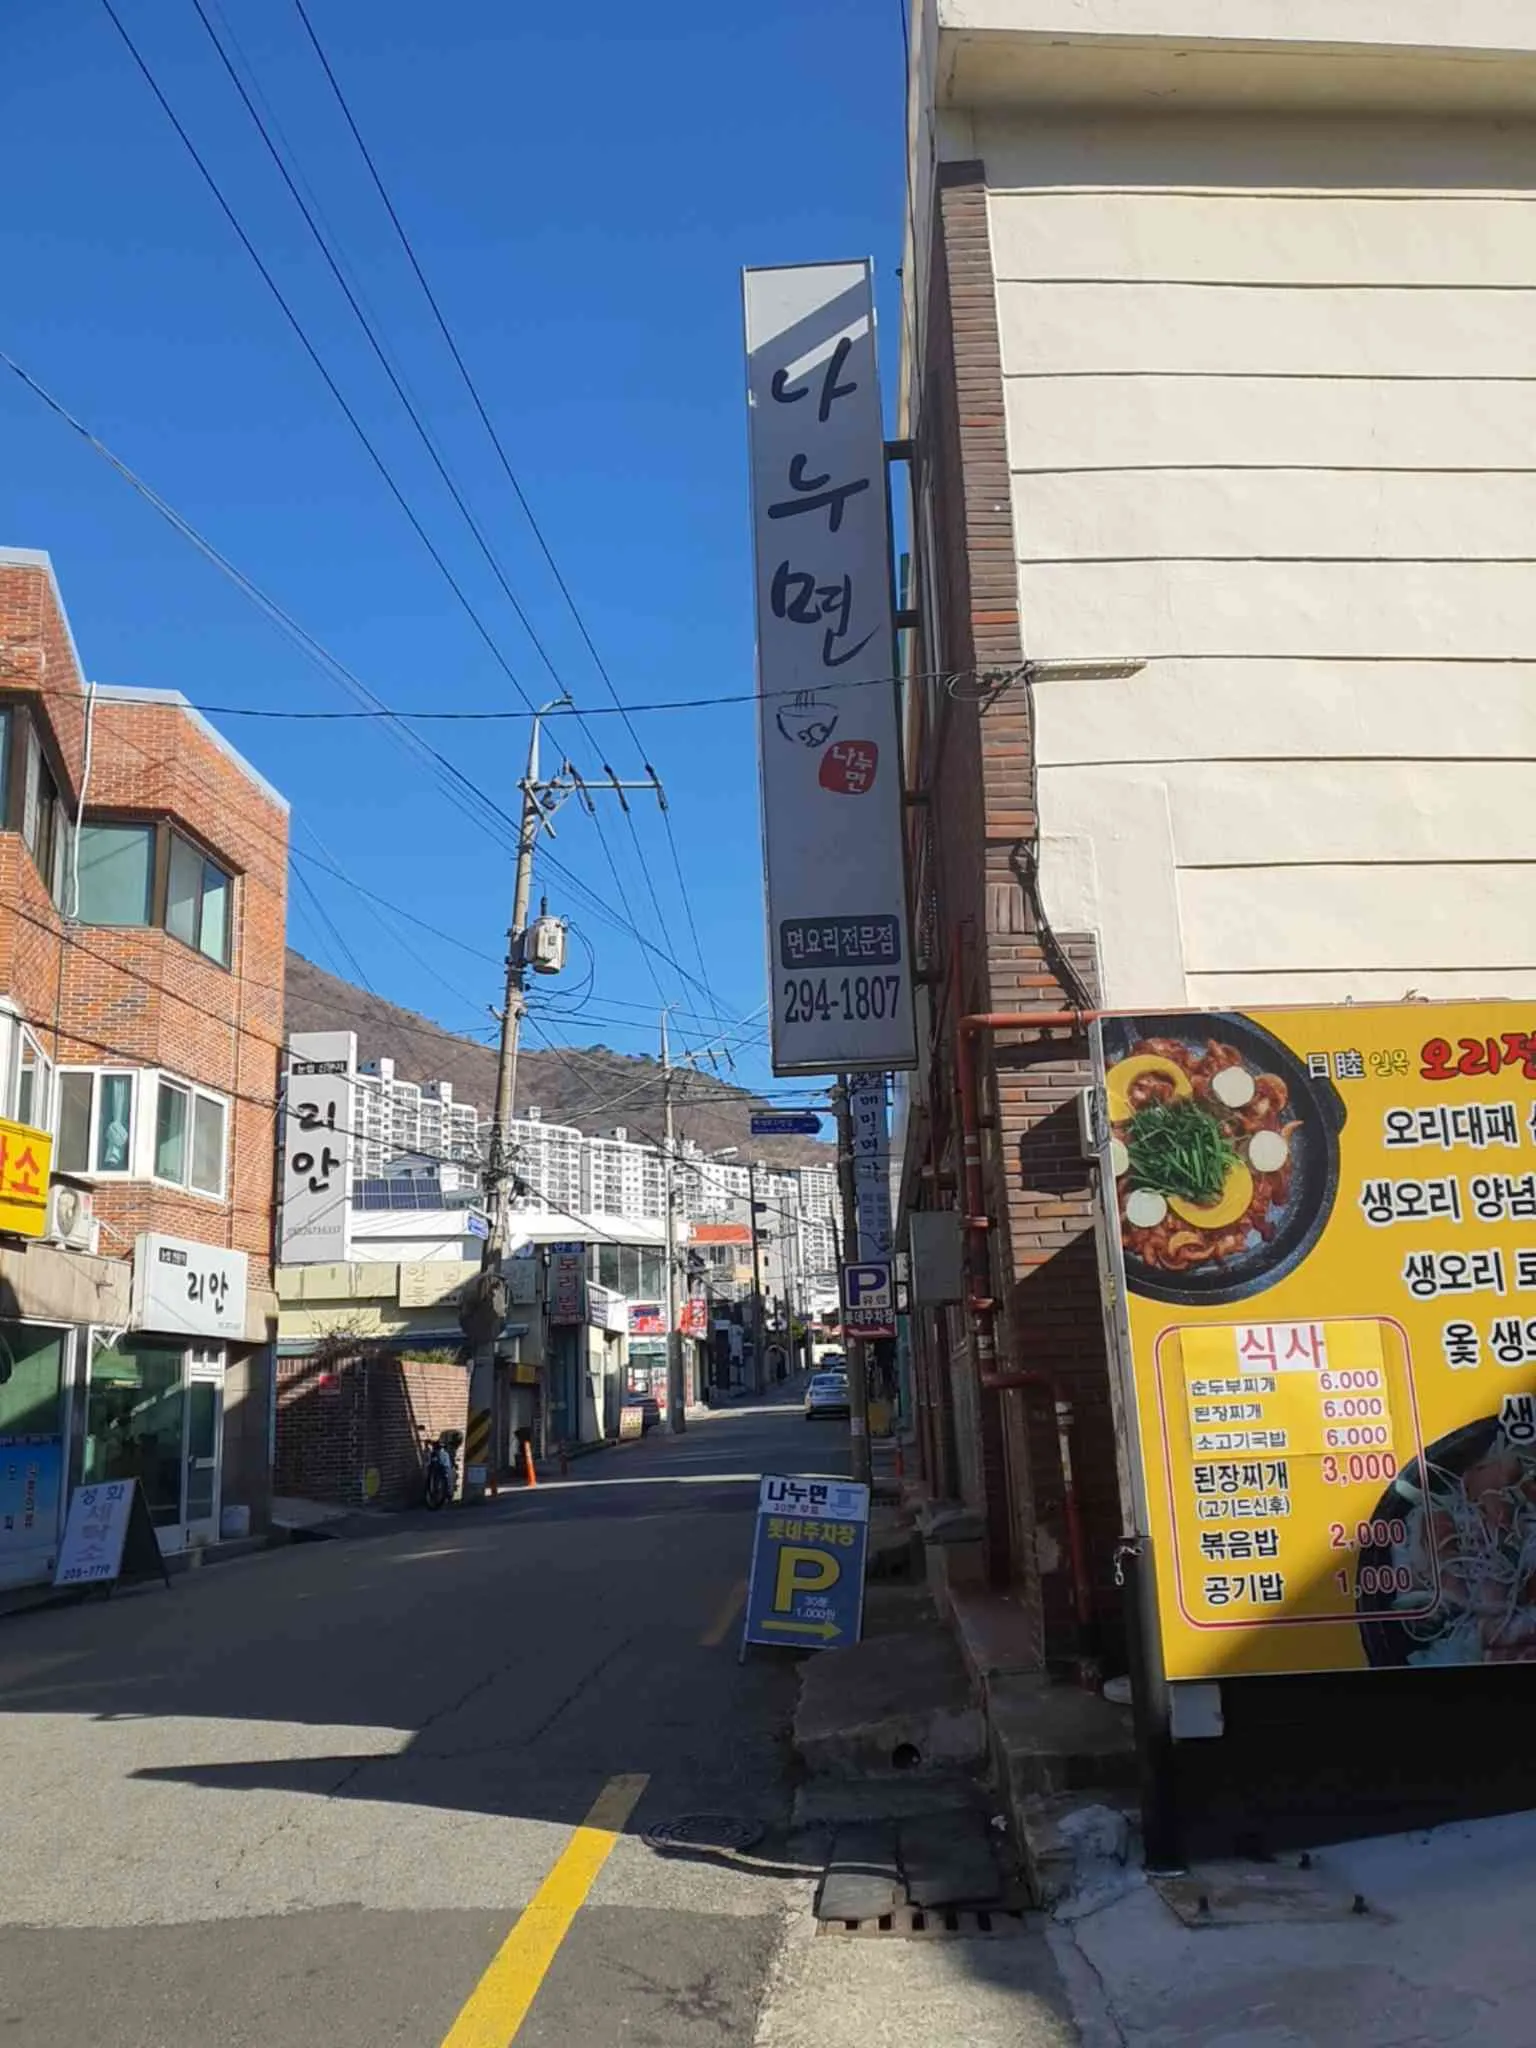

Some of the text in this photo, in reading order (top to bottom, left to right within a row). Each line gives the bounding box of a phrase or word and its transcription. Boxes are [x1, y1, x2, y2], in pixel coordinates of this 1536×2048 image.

[767, 335, 881, 667] 나누면
[832, 745, 873, 772] 나누
[845, 770, 867, 792] 면
[786, 923, 895, 960] 면요리전문점
[783, 974, 901, 1024] 294-1807
[1385, 1104, 1518, 1147] 오리대패
[291, 1100, 341, 1195] 리안
[1361, 1175, 1536, 1223] 생오리 양념
[187, 1270, 229, 1315] 리안
[849, 1269, 887, 1306] P
[1404, 1252, 1505, 1296] 생오리
[1240, 1325, 1325, 1371] 식사
[1319, 1370, 1379, 1390] 6.000
[1193, 1398, 1383, 1423] 된장찌개 6.000
[1196, 1426, 1388, 1451] 소고기국밥 6.000
[767, 1481, 829, 1505] 나누면
[1193, 1453, 1397, 1494] 된장찌개 3,000
[1198, 1497, 1291, 1520] (고기드신후)
[1201, 1520, 1406, 1561] 볶음밥 2,000
[771, 1545, 841, 1613] P
[1204, 1566, 1411, 1605] 공기밥 1,000
